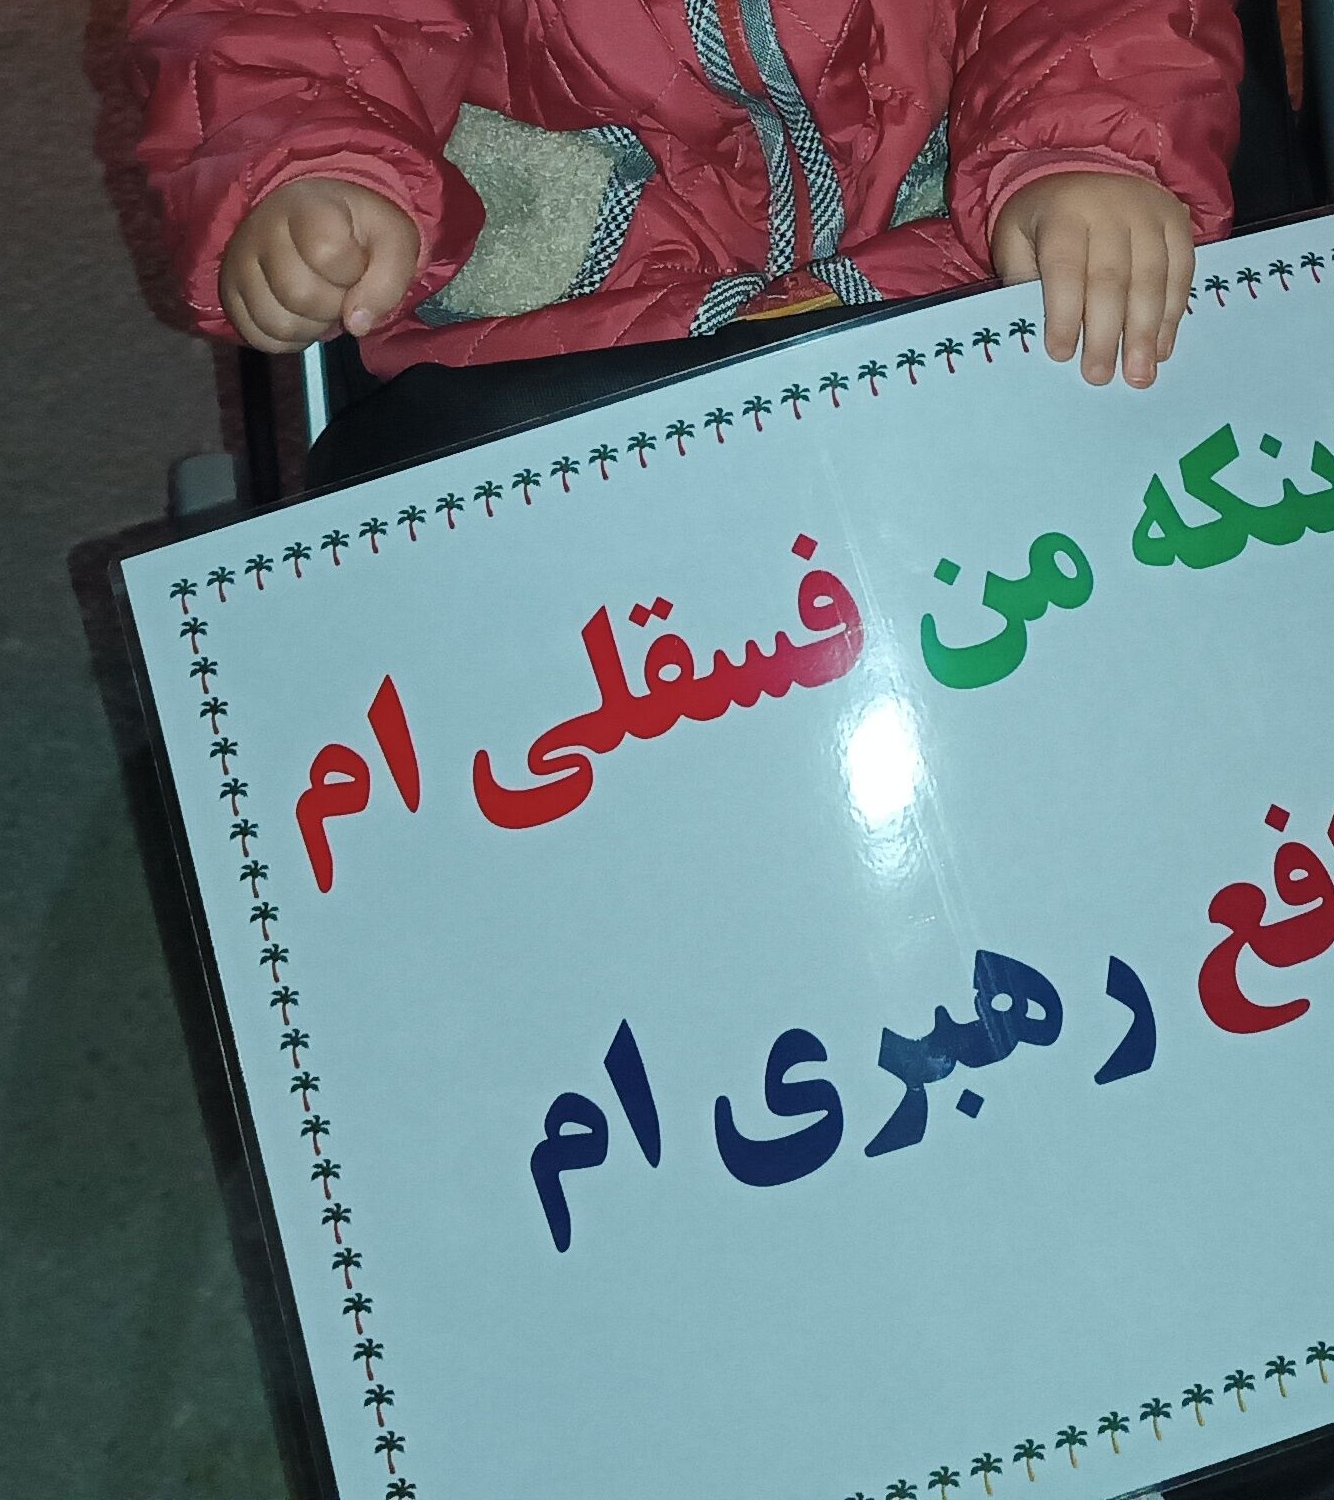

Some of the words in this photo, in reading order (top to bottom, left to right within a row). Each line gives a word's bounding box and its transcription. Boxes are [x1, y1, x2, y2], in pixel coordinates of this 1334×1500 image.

[472, 533, 866, 831] فسقلی
[920, 531, 1095, 690] من
[295, 674, 422, 895] ام
[529, 1018, 663, 1255] ام
[714, 949, 1158, 1189] رهبری
